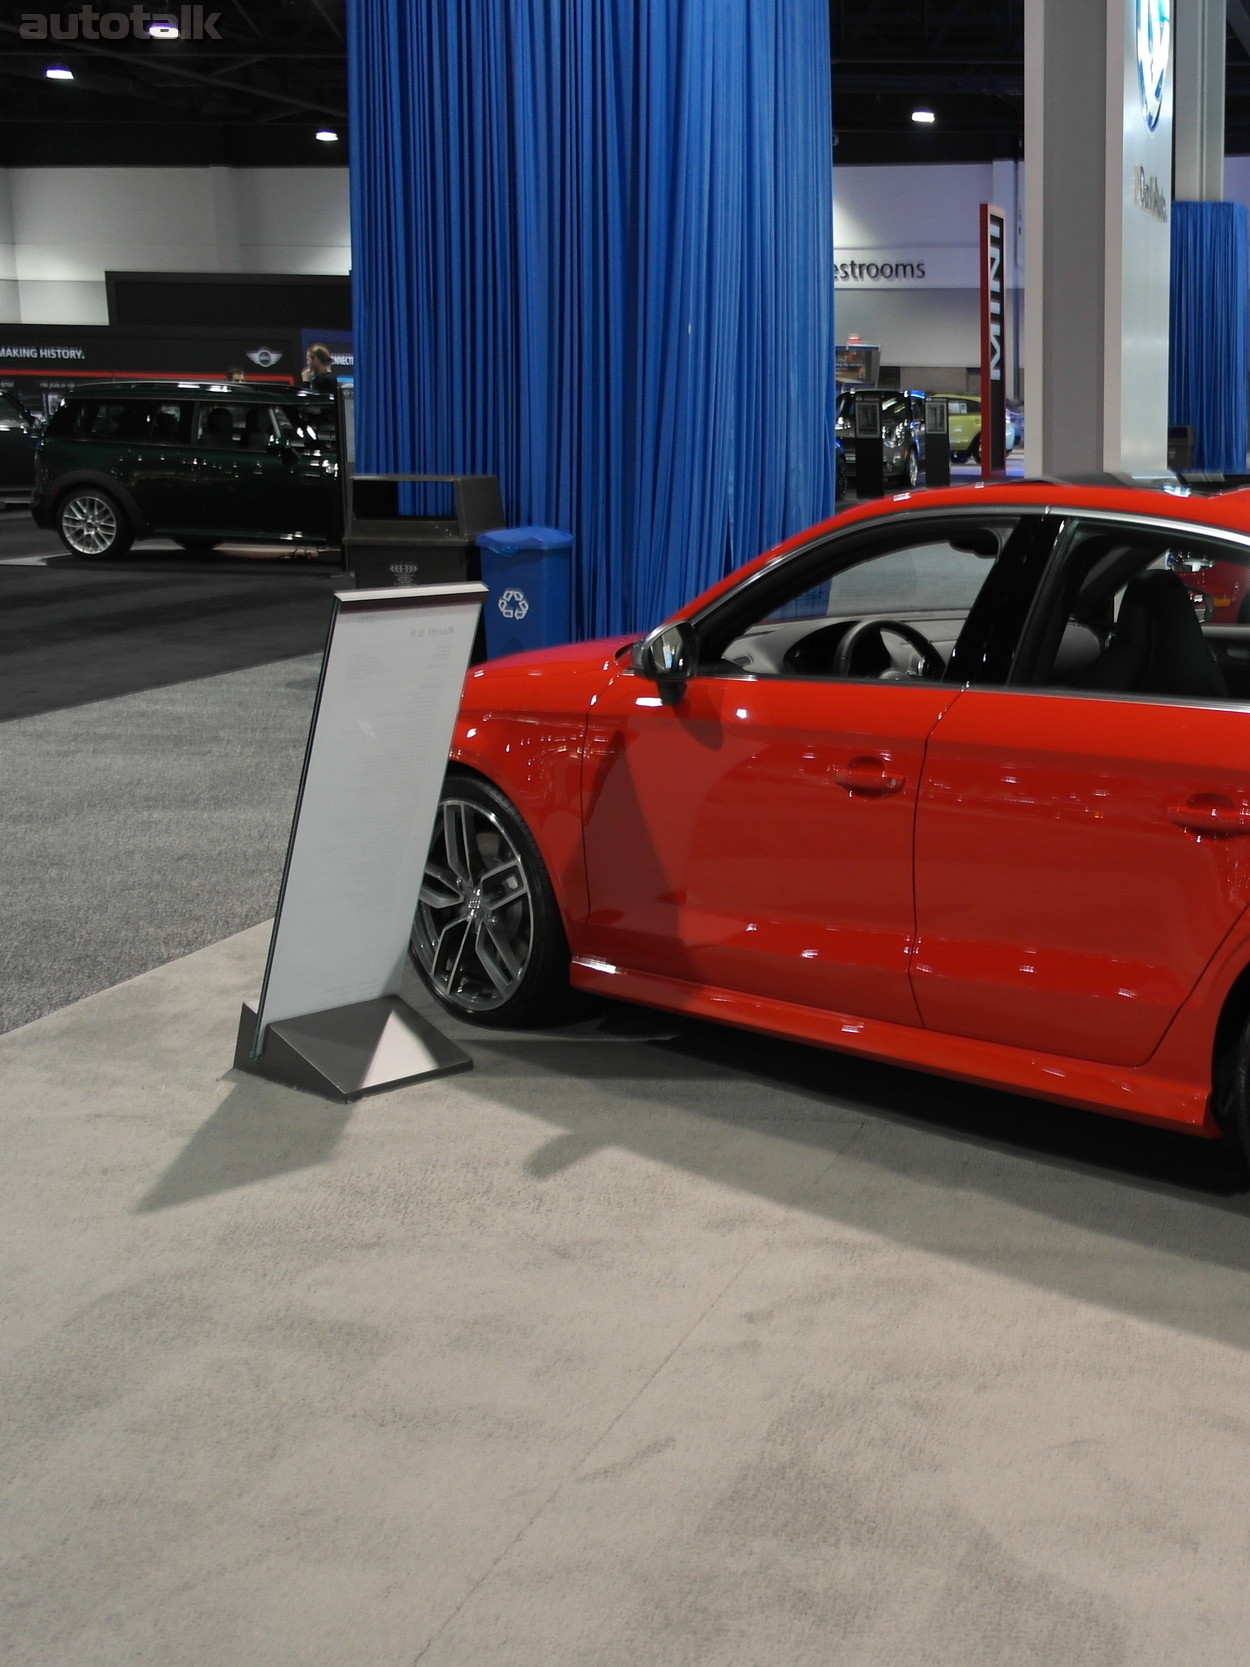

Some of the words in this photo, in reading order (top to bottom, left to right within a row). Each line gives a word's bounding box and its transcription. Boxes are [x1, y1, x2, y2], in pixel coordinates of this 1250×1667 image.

[989, 223, 1001, 381] MINI
[0, 348, 37, 358] MAKING
[40, 348, 85, 359] HISTORY.
